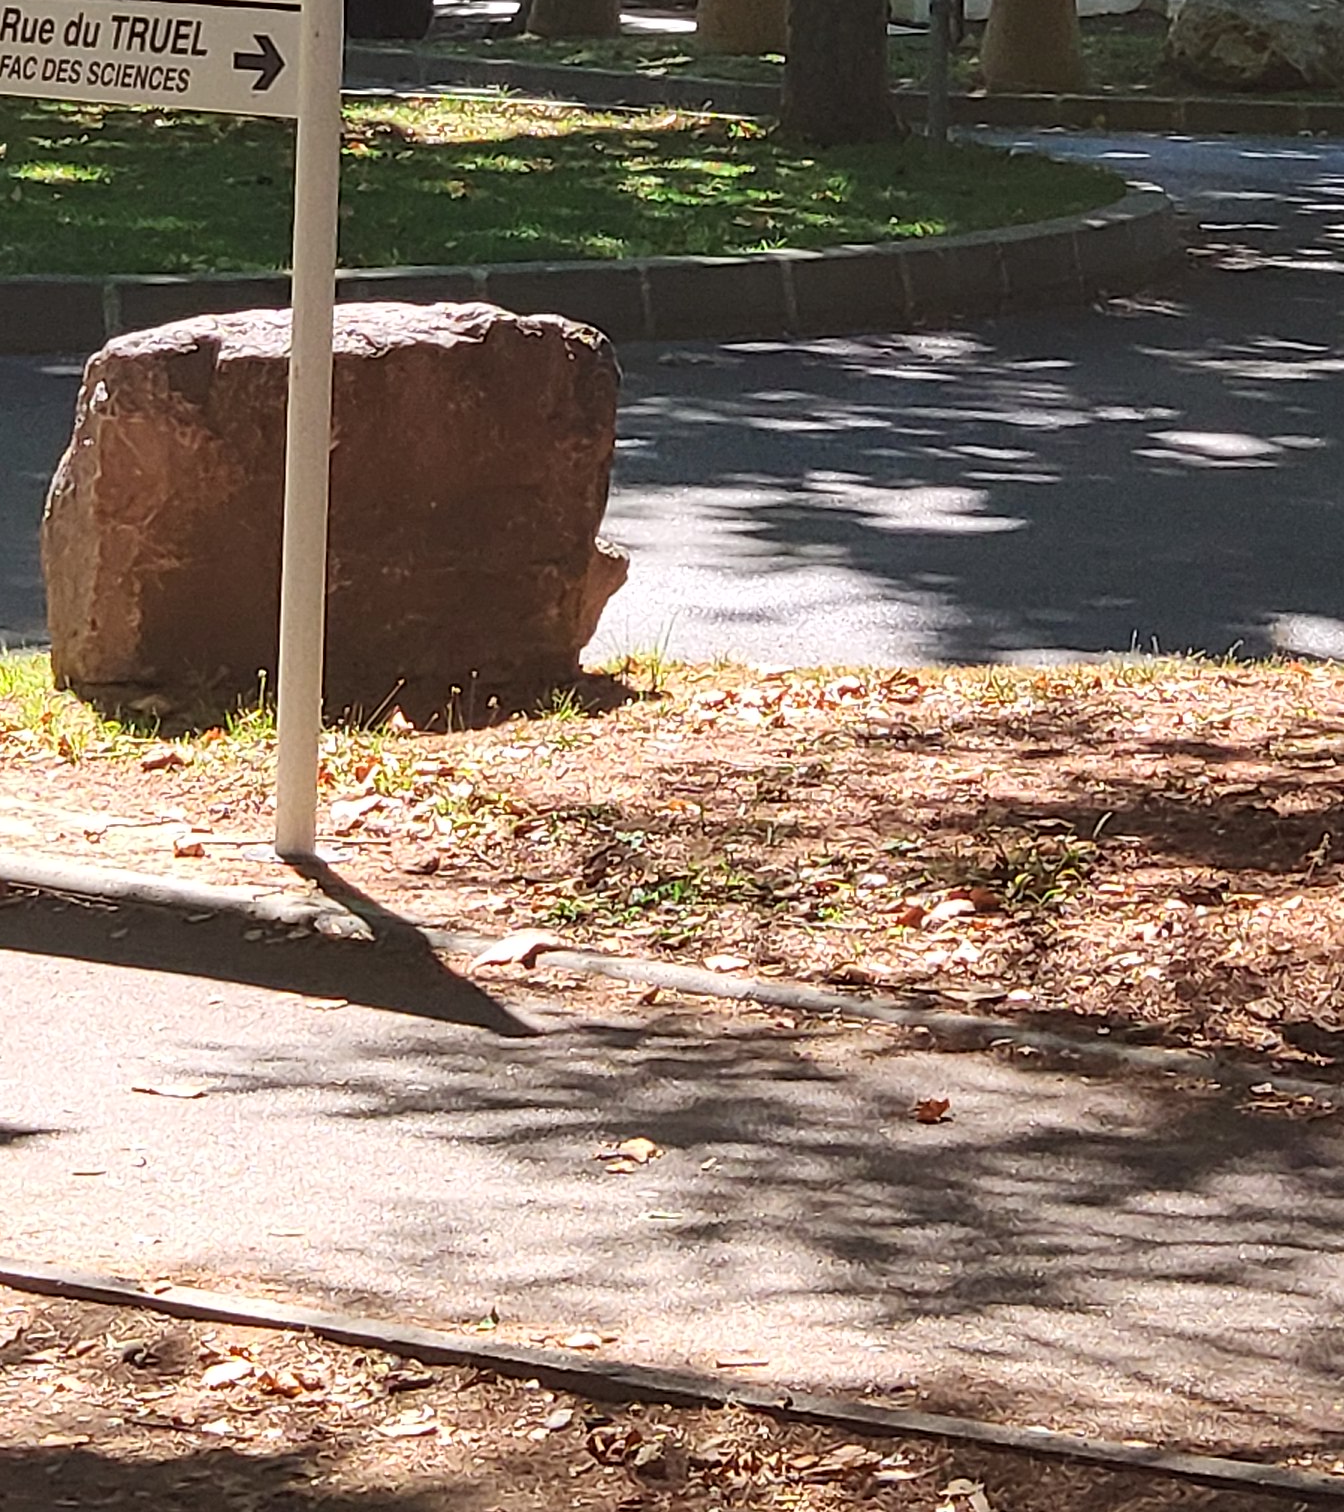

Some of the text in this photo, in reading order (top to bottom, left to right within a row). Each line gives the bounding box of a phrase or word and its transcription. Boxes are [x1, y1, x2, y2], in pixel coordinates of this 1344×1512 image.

[0, 7, 208, 56] Rue du TRUEL
[42, 59, 83, 84] DES
[87, 61, 190, 93] SCIENCES
